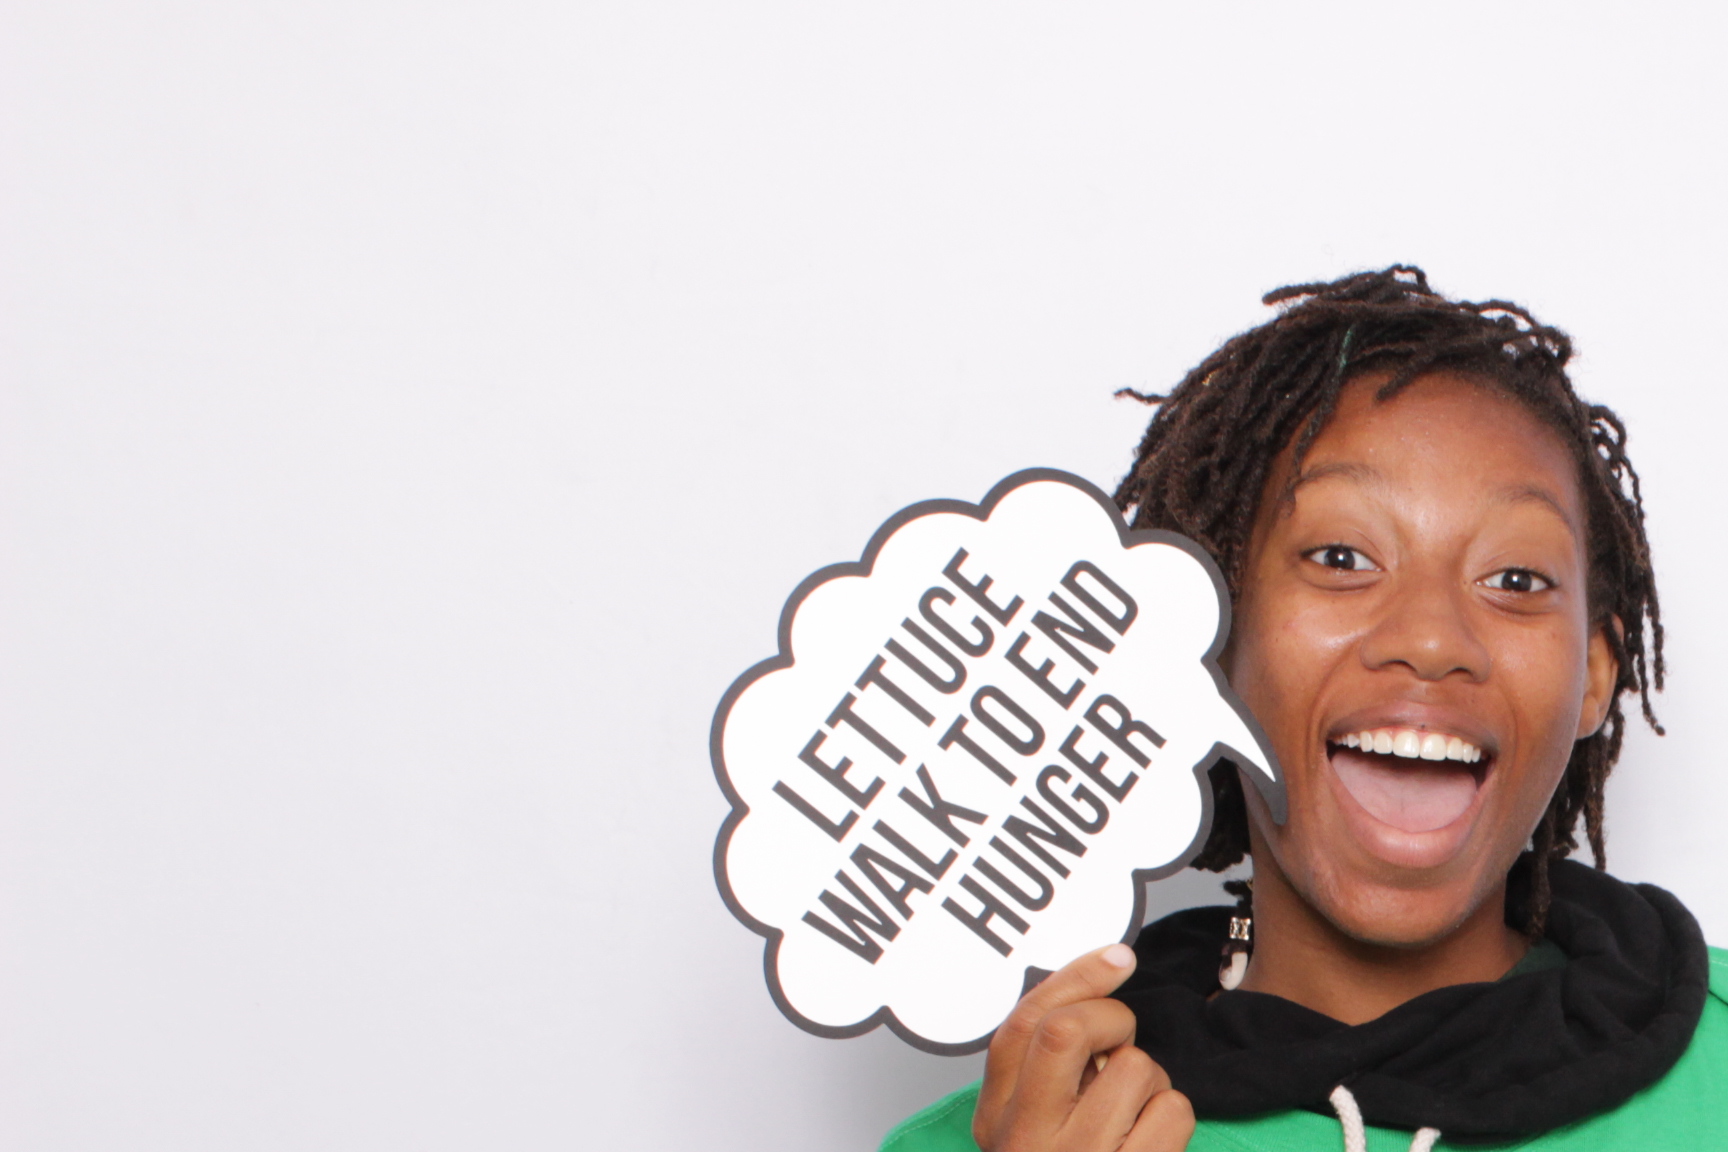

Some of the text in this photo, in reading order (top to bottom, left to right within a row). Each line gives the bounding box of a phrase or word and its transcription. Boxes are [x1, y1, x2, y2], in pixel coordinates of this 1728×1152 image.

[771, 547, 1025, 843] LETTUCE
[801, 559, 1139, 965] WALK TO END
[941, 693, 1167, 958] HUNGER
